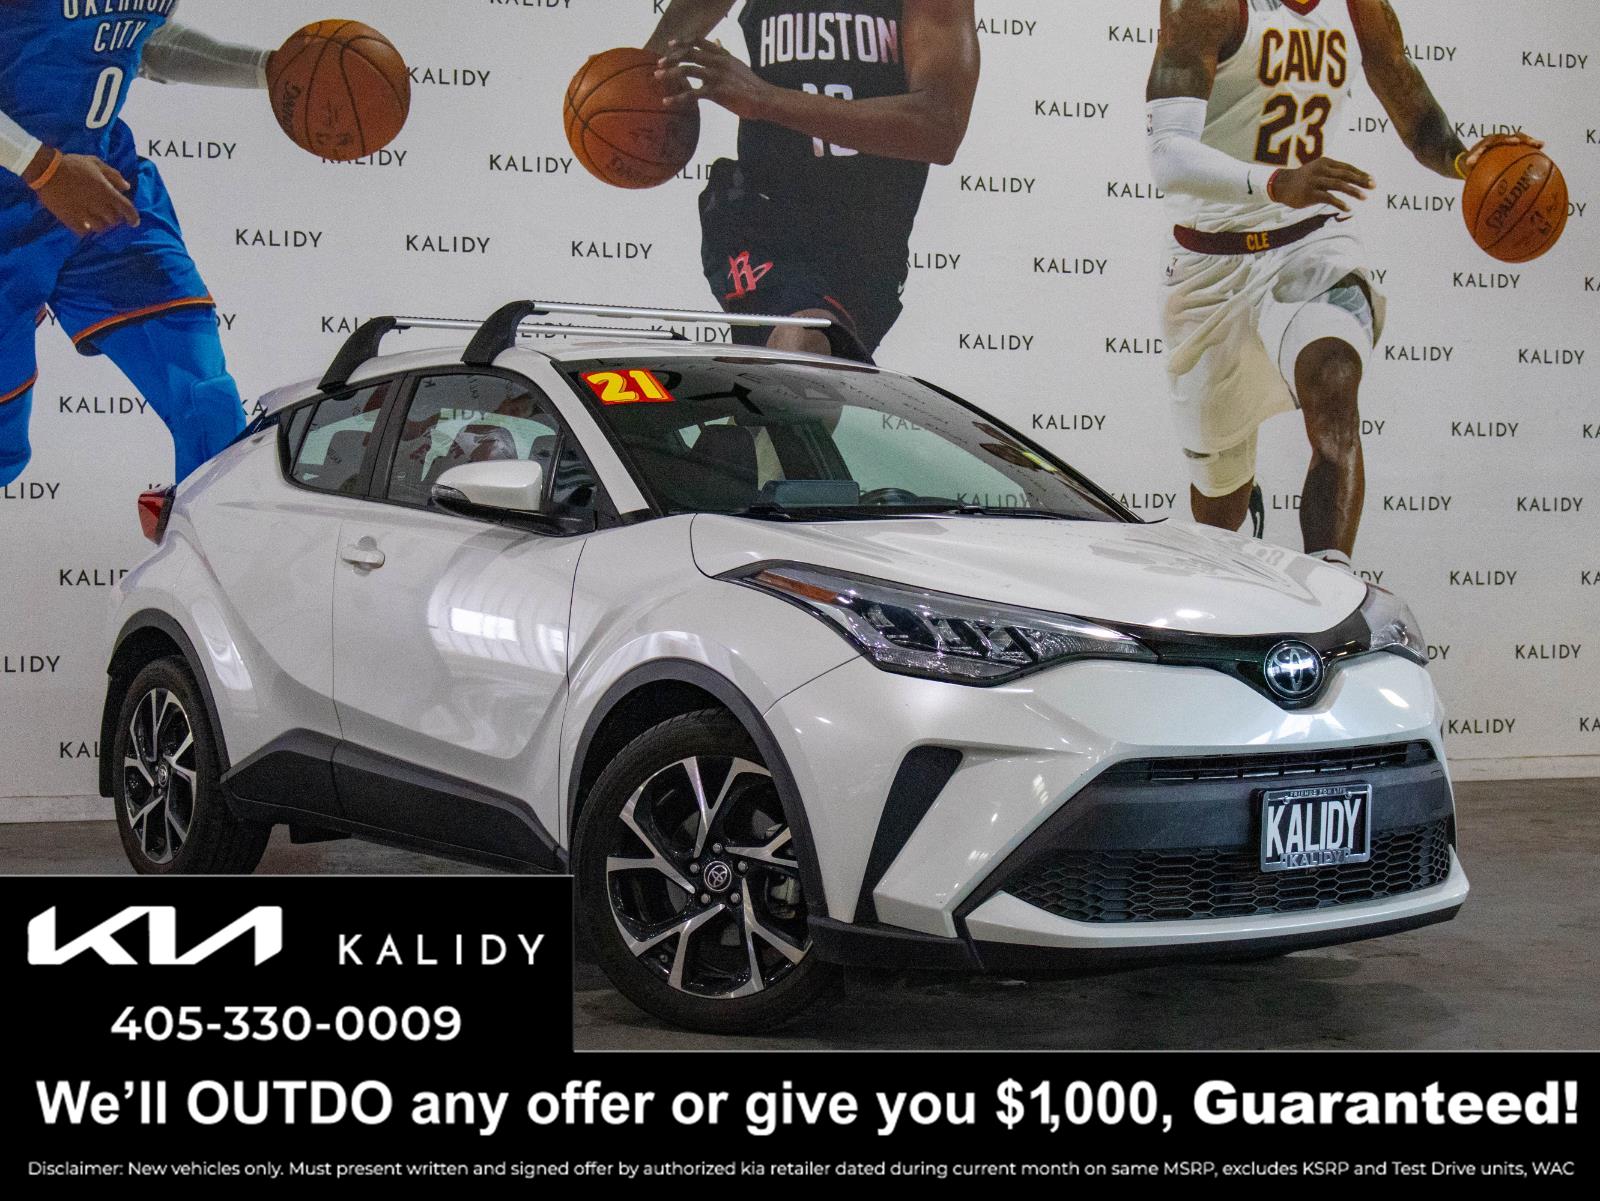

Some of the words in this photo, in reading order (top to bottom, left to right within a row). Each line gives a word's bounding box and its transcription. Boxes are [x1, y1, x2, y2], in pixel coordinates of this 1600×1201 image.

[94, 20, 146, 52] CITY
[976, 18, 1037, 36] ALIDY
[1108, 25, 1162, 44] KALI
[760, 12, 899, 67] HOUSTON
[1258, 28, 1347, 88] CAVS
[1404, 46, 1457, 63] ALIDY
[1522, 51, 1588, 70] KALIDY
[408, 67, 491, 87] KALIDY
[85, 66, 124, 129] 0
[1035, 100, 1109, 119] KALIDY
[1254, 93, 1332, 166] 23
[148, 139, 237, 160] KALIDY
[489, 154, 573, 174] KALIDY
[960, 175, 1036, 194] KALIDY
[1387, 194, 1456, 212] KALIDY
[235, 228, 323, 248] KALIDY
[406, 234, 491, 254] KALIDY
[1246, 231, 1270, 251] CLE
[571, 240, 653, 260] KALIDY
[907, 252, 961, 270] LIDY
[1033, 257, 1108, 275] KALIDY
[1453, 272, 1521, 289] KALIDY
[959, 333, 1034, 351] KALIDY
[1105, 337, 1163, 354] KALID
[1385, 345, 1454, 362] KALIDY
[1518, 348, 1585, 365] KALIDY
[587, 369, 670, 402] 21
[59, 396, 147, 415] KALIDY
[1032, 413, 1106, 431] KALIDY
[1451, 421, 1519, 438] KALIDY
[4, 481, 60, 500] LIDY
[1110, 493, 1177, 509] ALIDY
[1272, 494, 1303, 511] LID
[1383, 495, 1452, 511] KALIDY
[1517, 496, 1583, 512] KALIDY
[1449, 570, 1517, 586] KALIDY
[1515, 644, 1582, 660] KALIDY
[0, 655, 61, 673] LIDY
[1448, 718, 1516, 734] KALIDY
[59, 741, 101, 759] KAL
[1266, 798, 1362, 858] KALIDY
[1288, 850, 1342, 868] KALIDY
